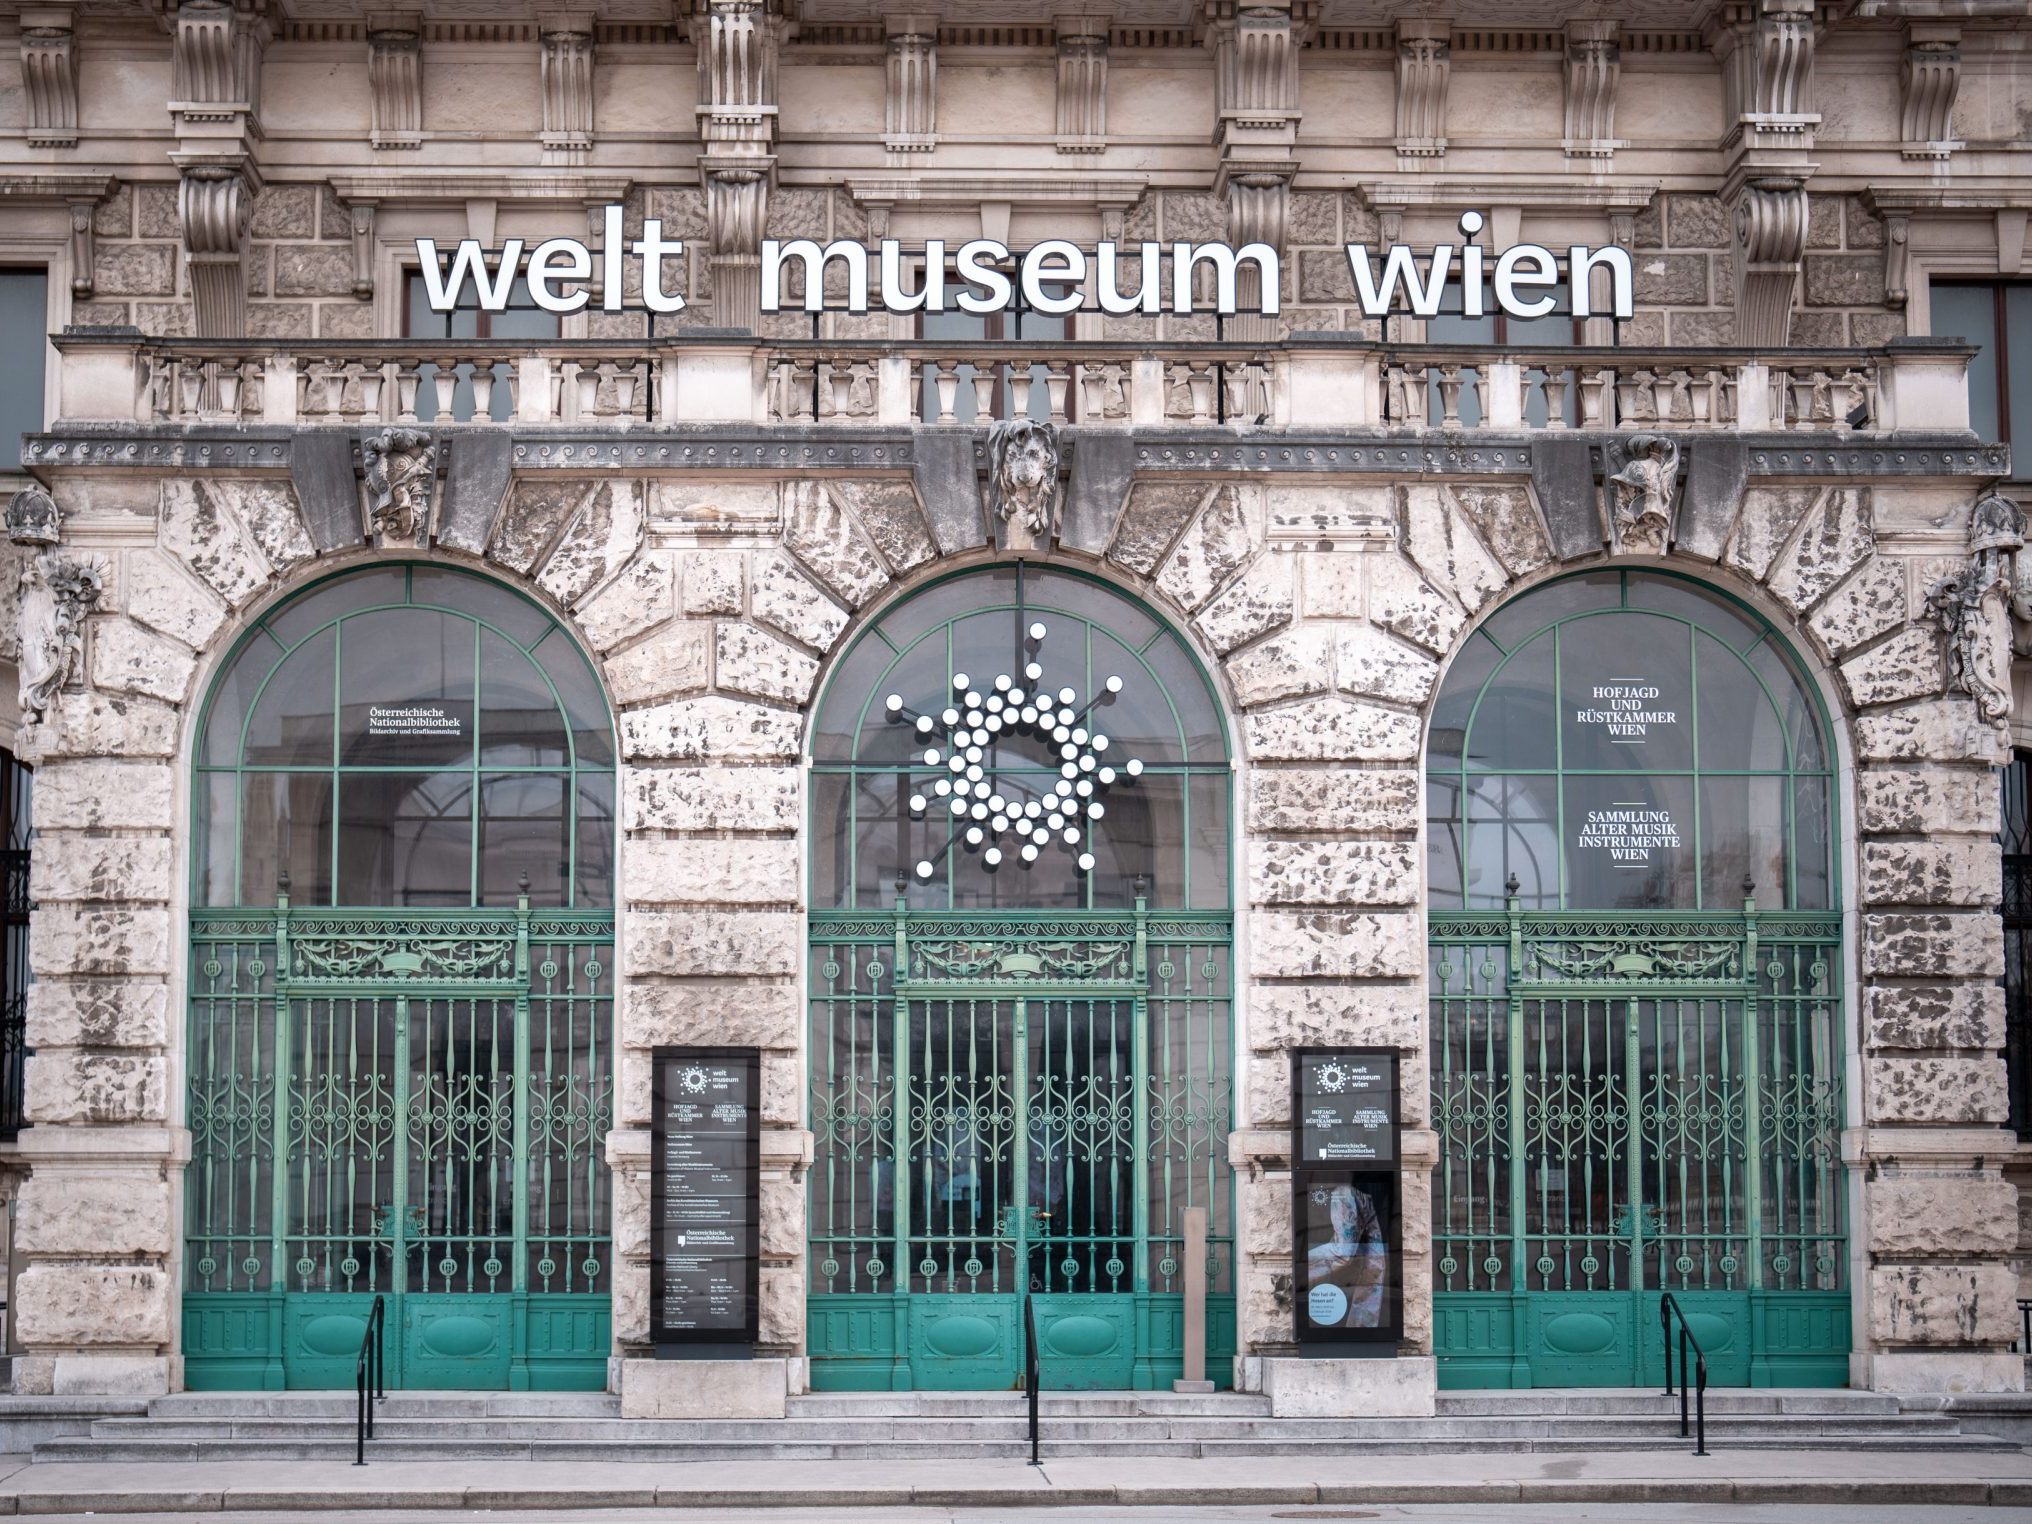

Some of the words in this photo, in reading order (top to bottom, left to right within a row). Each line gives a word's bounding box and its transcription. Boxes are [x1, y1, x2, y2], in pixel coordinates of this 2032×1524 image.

[414, 205, 687, 315] welt
[760, 238, 1280, 318] museum
[1344, 209, 1634, 321] wien
[1592, 687, 1659, 698] HOFJAGD
[1611, 699, 1642, 711] UND
[369, 706, 444, 717] Österreichische
[1577, 708, 1676, 723] RÜSTKAMMER
[369, 717, 461, 727] Nationalbibliothek
[412, 728, 461, 736] Grafiksammlung
[1607, 724, 1646, 736] WIEN
[1588, 811, 1669, 823] SAMMLUNG
[1581, 823, 1628, 835] ALTER
[1631, 823, 1677, 835] MUSIK
[1578, 836, 1681, 848] INSTRUMENTE
[1610, 848, 1649, 860] WIEN
